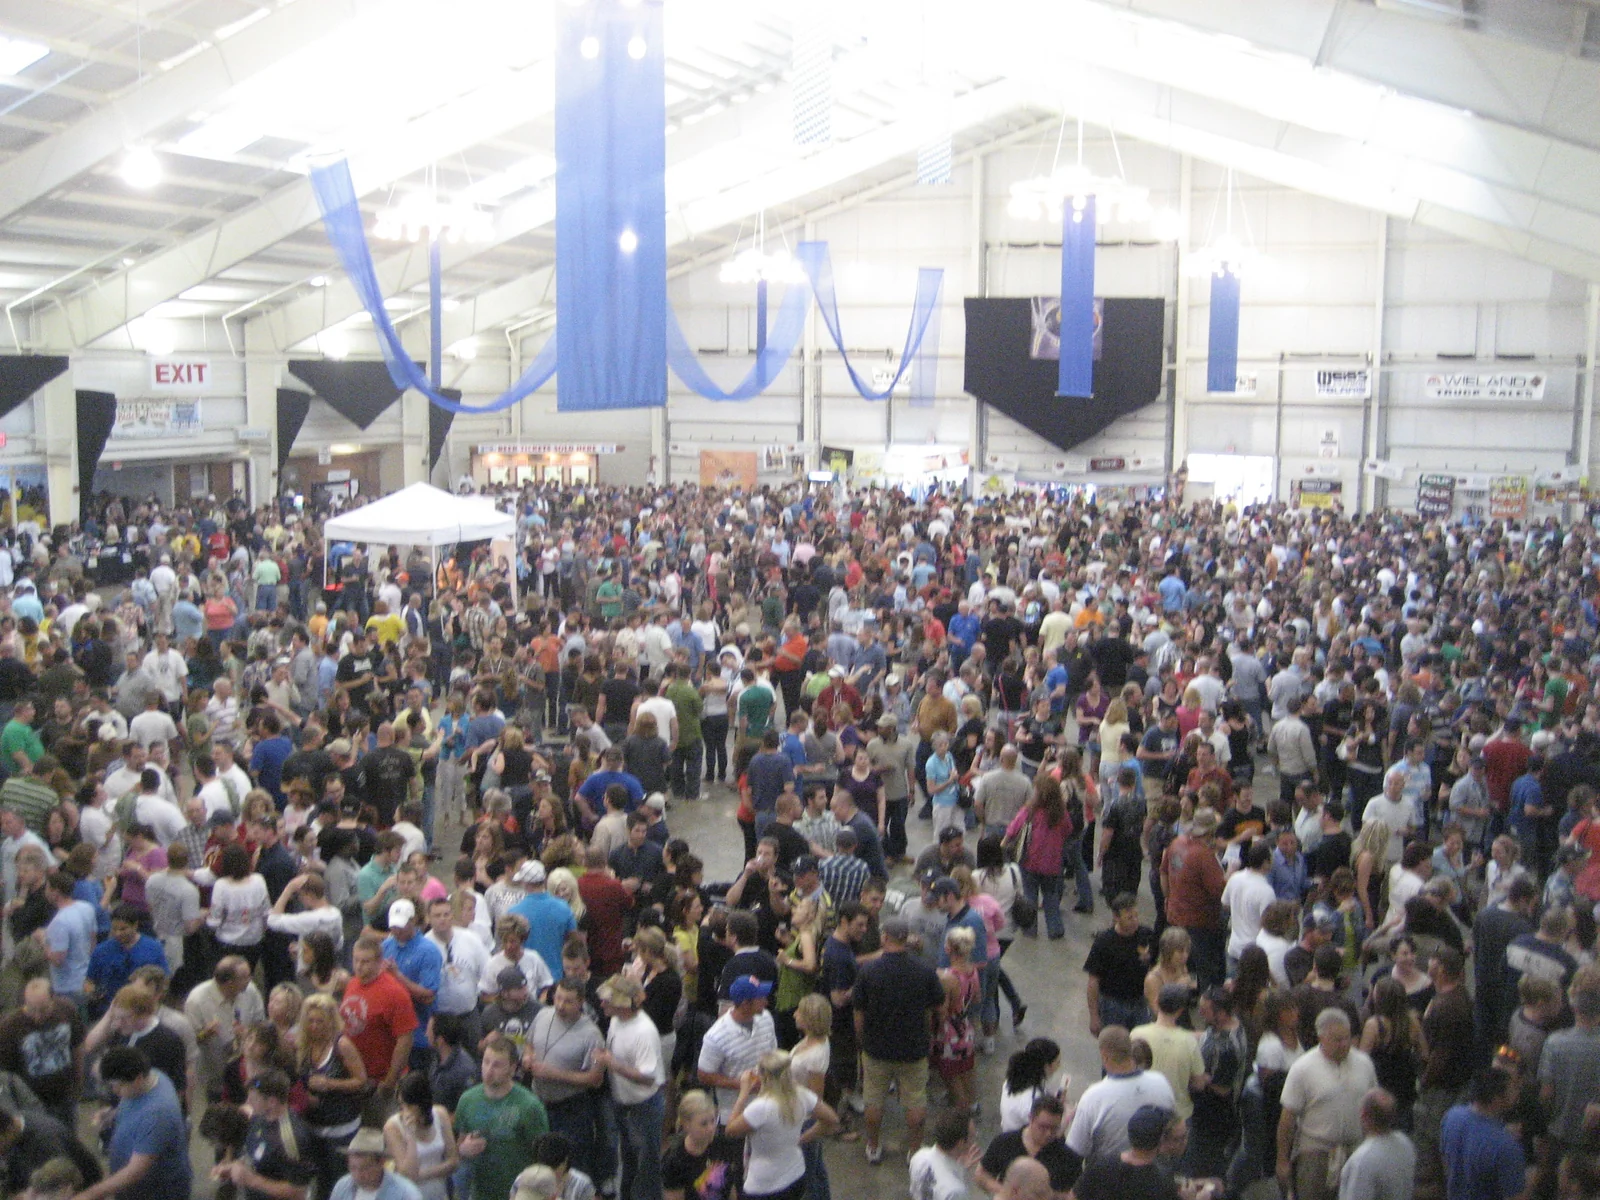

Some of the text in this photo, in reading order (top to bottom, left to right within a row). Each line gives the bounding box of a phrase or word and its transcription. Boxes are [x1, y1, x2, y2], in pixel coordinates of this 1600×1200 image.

[155, 363, 207, 384] EXIT
[1443, 374, 1526, 387] WIELAND
[520, 445, 551, 453] TICKETS
